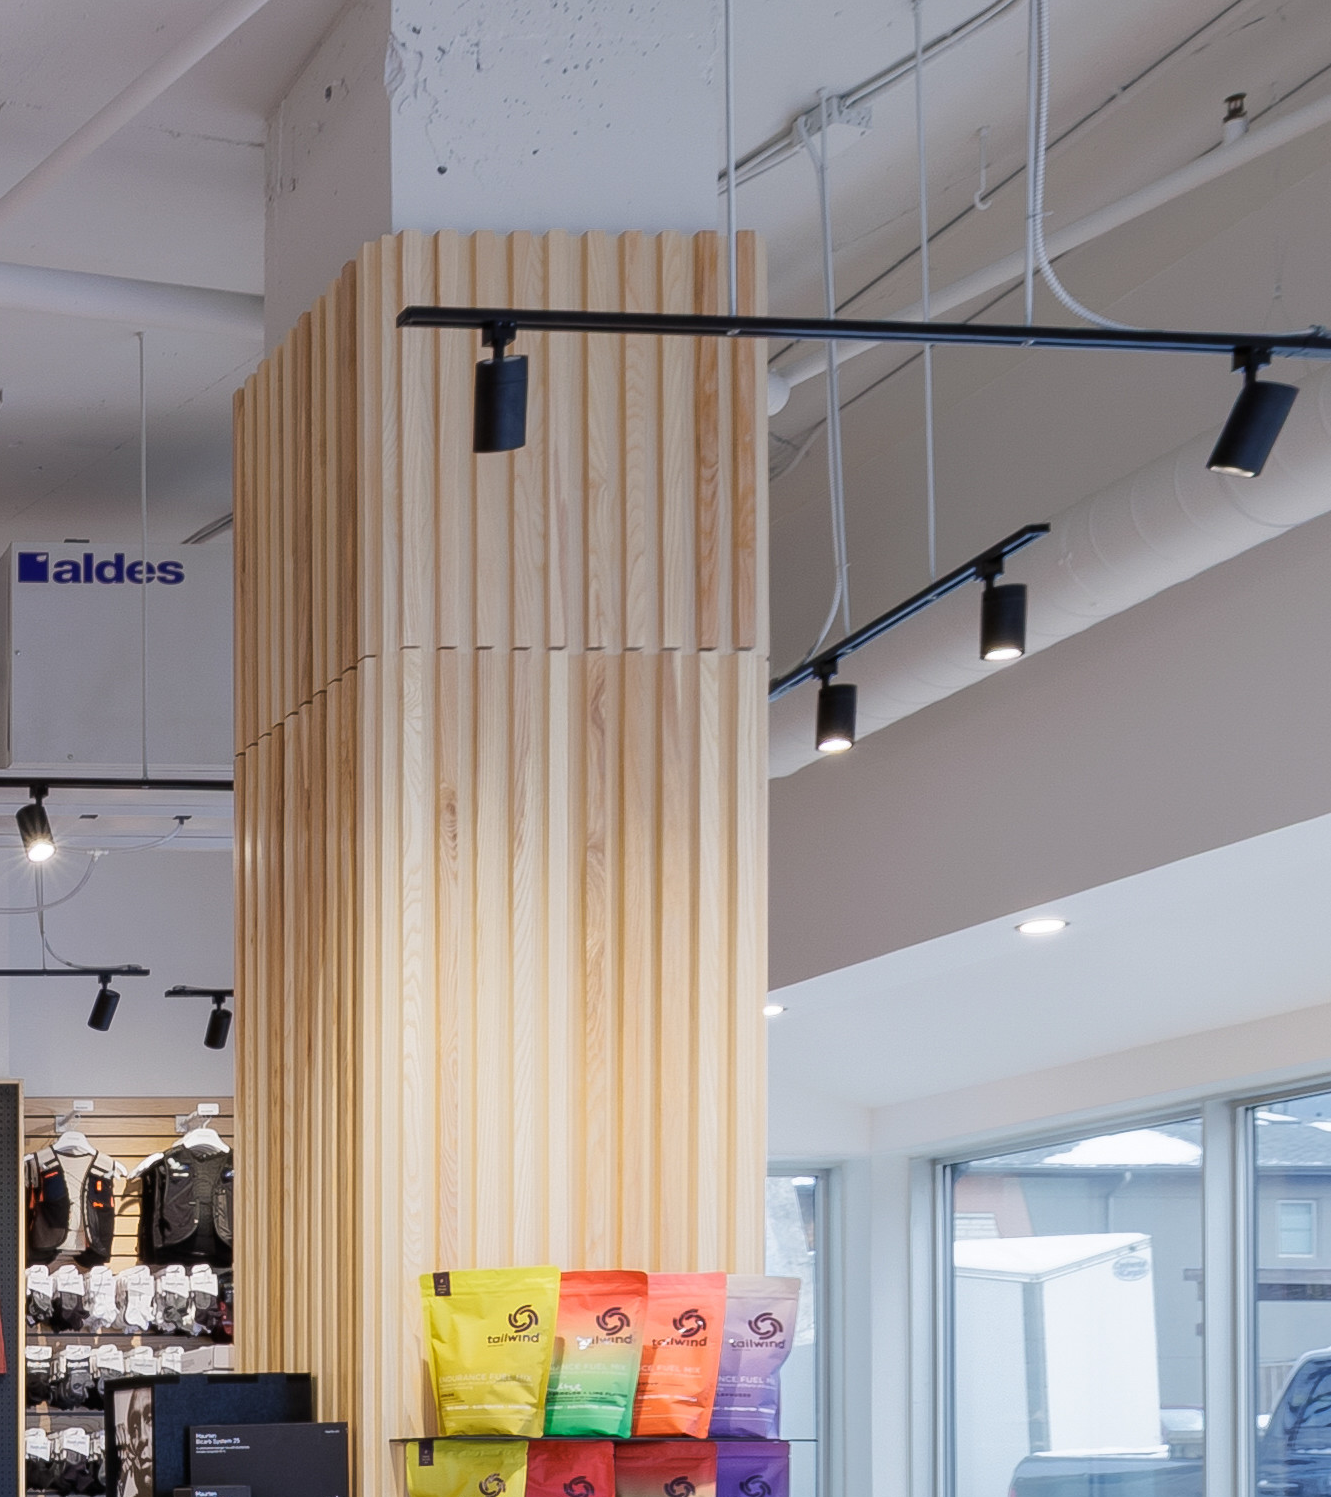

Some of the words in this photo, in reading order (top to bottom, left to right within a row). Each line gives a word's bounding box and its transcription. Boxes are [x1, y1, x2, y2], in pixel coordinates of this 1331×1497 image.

[52, 553, 185, 585] aldes
[487, 1333, 540, 1344] tailwind
[576, 1335, 633, 1345] ilwind
[740, 1376, 764, 1384] FUEL
